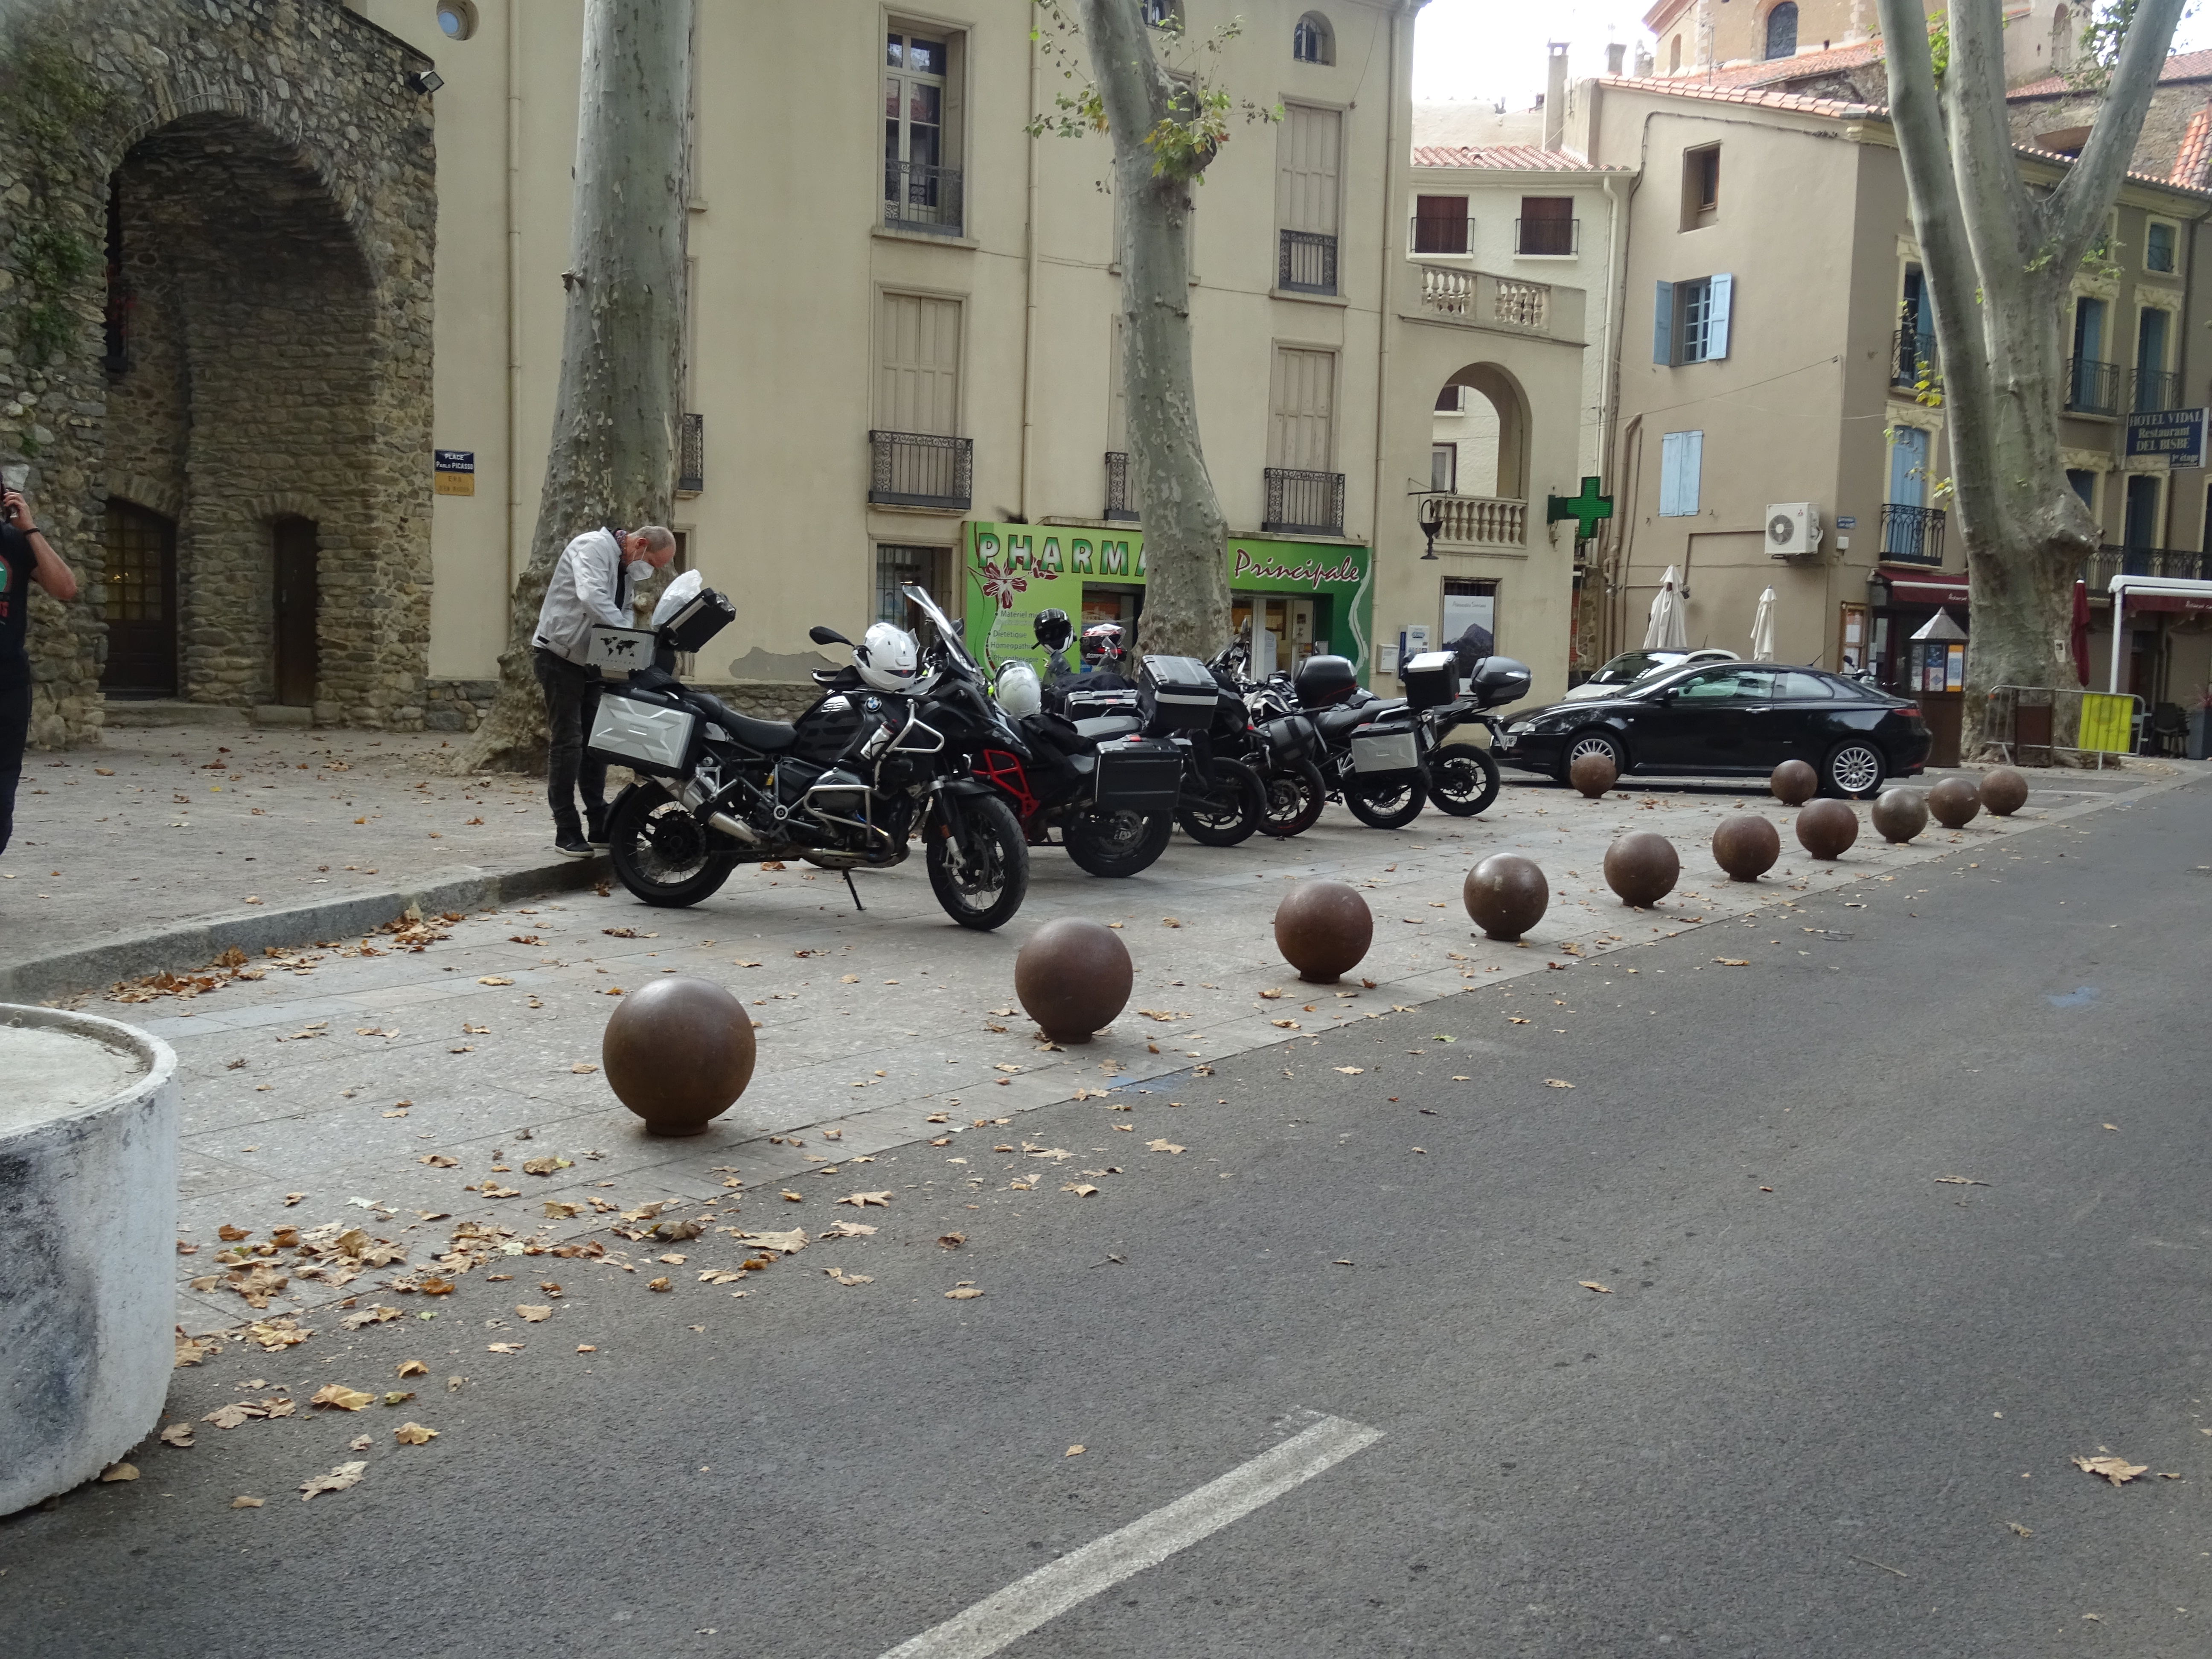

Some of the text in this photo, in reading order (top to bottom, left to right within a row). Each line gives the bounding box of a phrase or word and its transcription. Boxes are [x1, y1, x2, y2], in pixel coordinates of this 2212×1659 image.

[2129, 411, 2201, 426] HOTEL VIDAL
[2139, 426, 2190, 438] Restaurant
[1234, 548, 1359, 590] Principale
